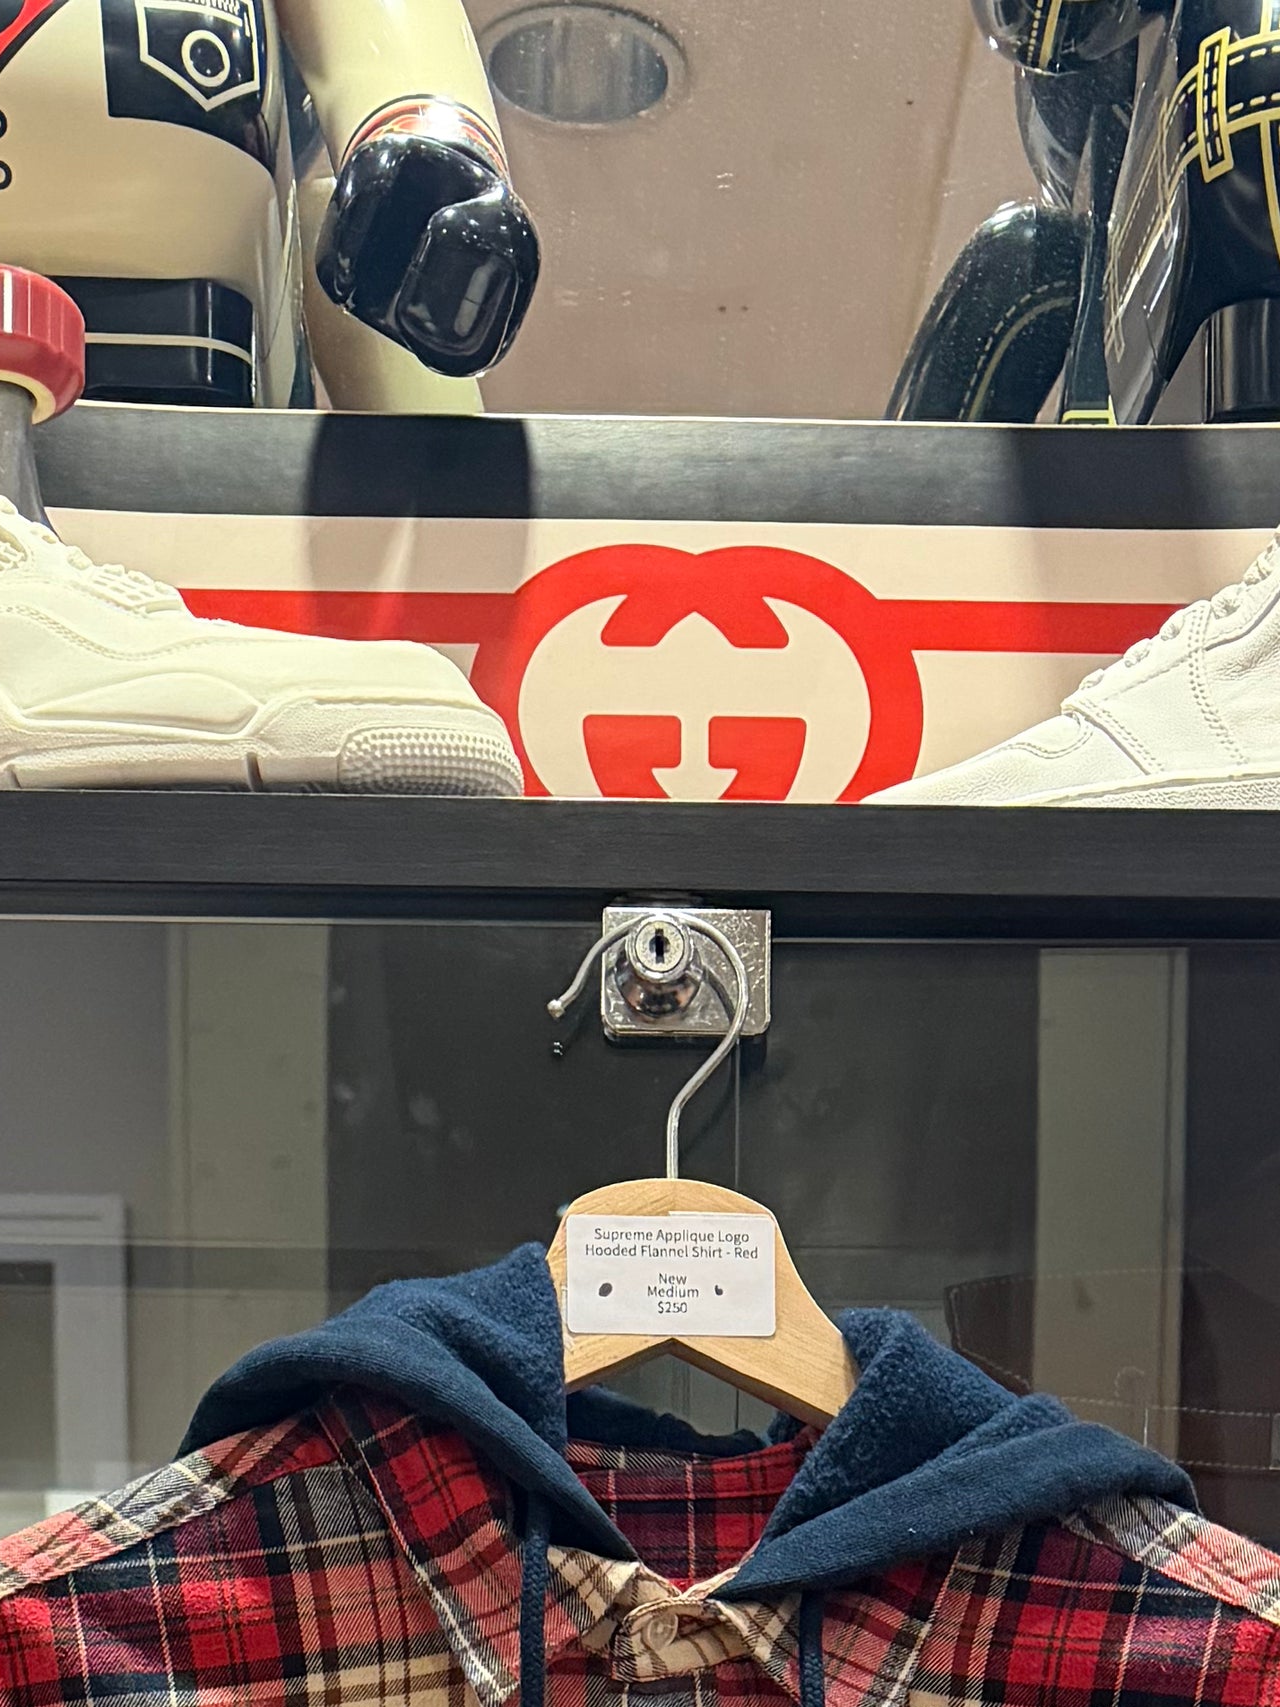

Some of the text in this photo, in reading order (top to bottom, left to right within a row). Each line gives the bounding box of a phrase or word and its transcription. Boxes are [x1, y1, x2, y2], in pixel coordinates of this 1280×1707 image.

[594, 1227, 750, 1246] Supreme Applique Logo
[584, 1244, 637, 1258] Hooded
[640, 1245, 689, 1258] Flannel
[691, 1246, 723, 1260] Shirt
[734, 1247, 759, 1260] Red
[657, 1273, 688, 1285] New
[646, 1285, 700, 1299] Medium
[656, 1301, 689, 1315] $250
